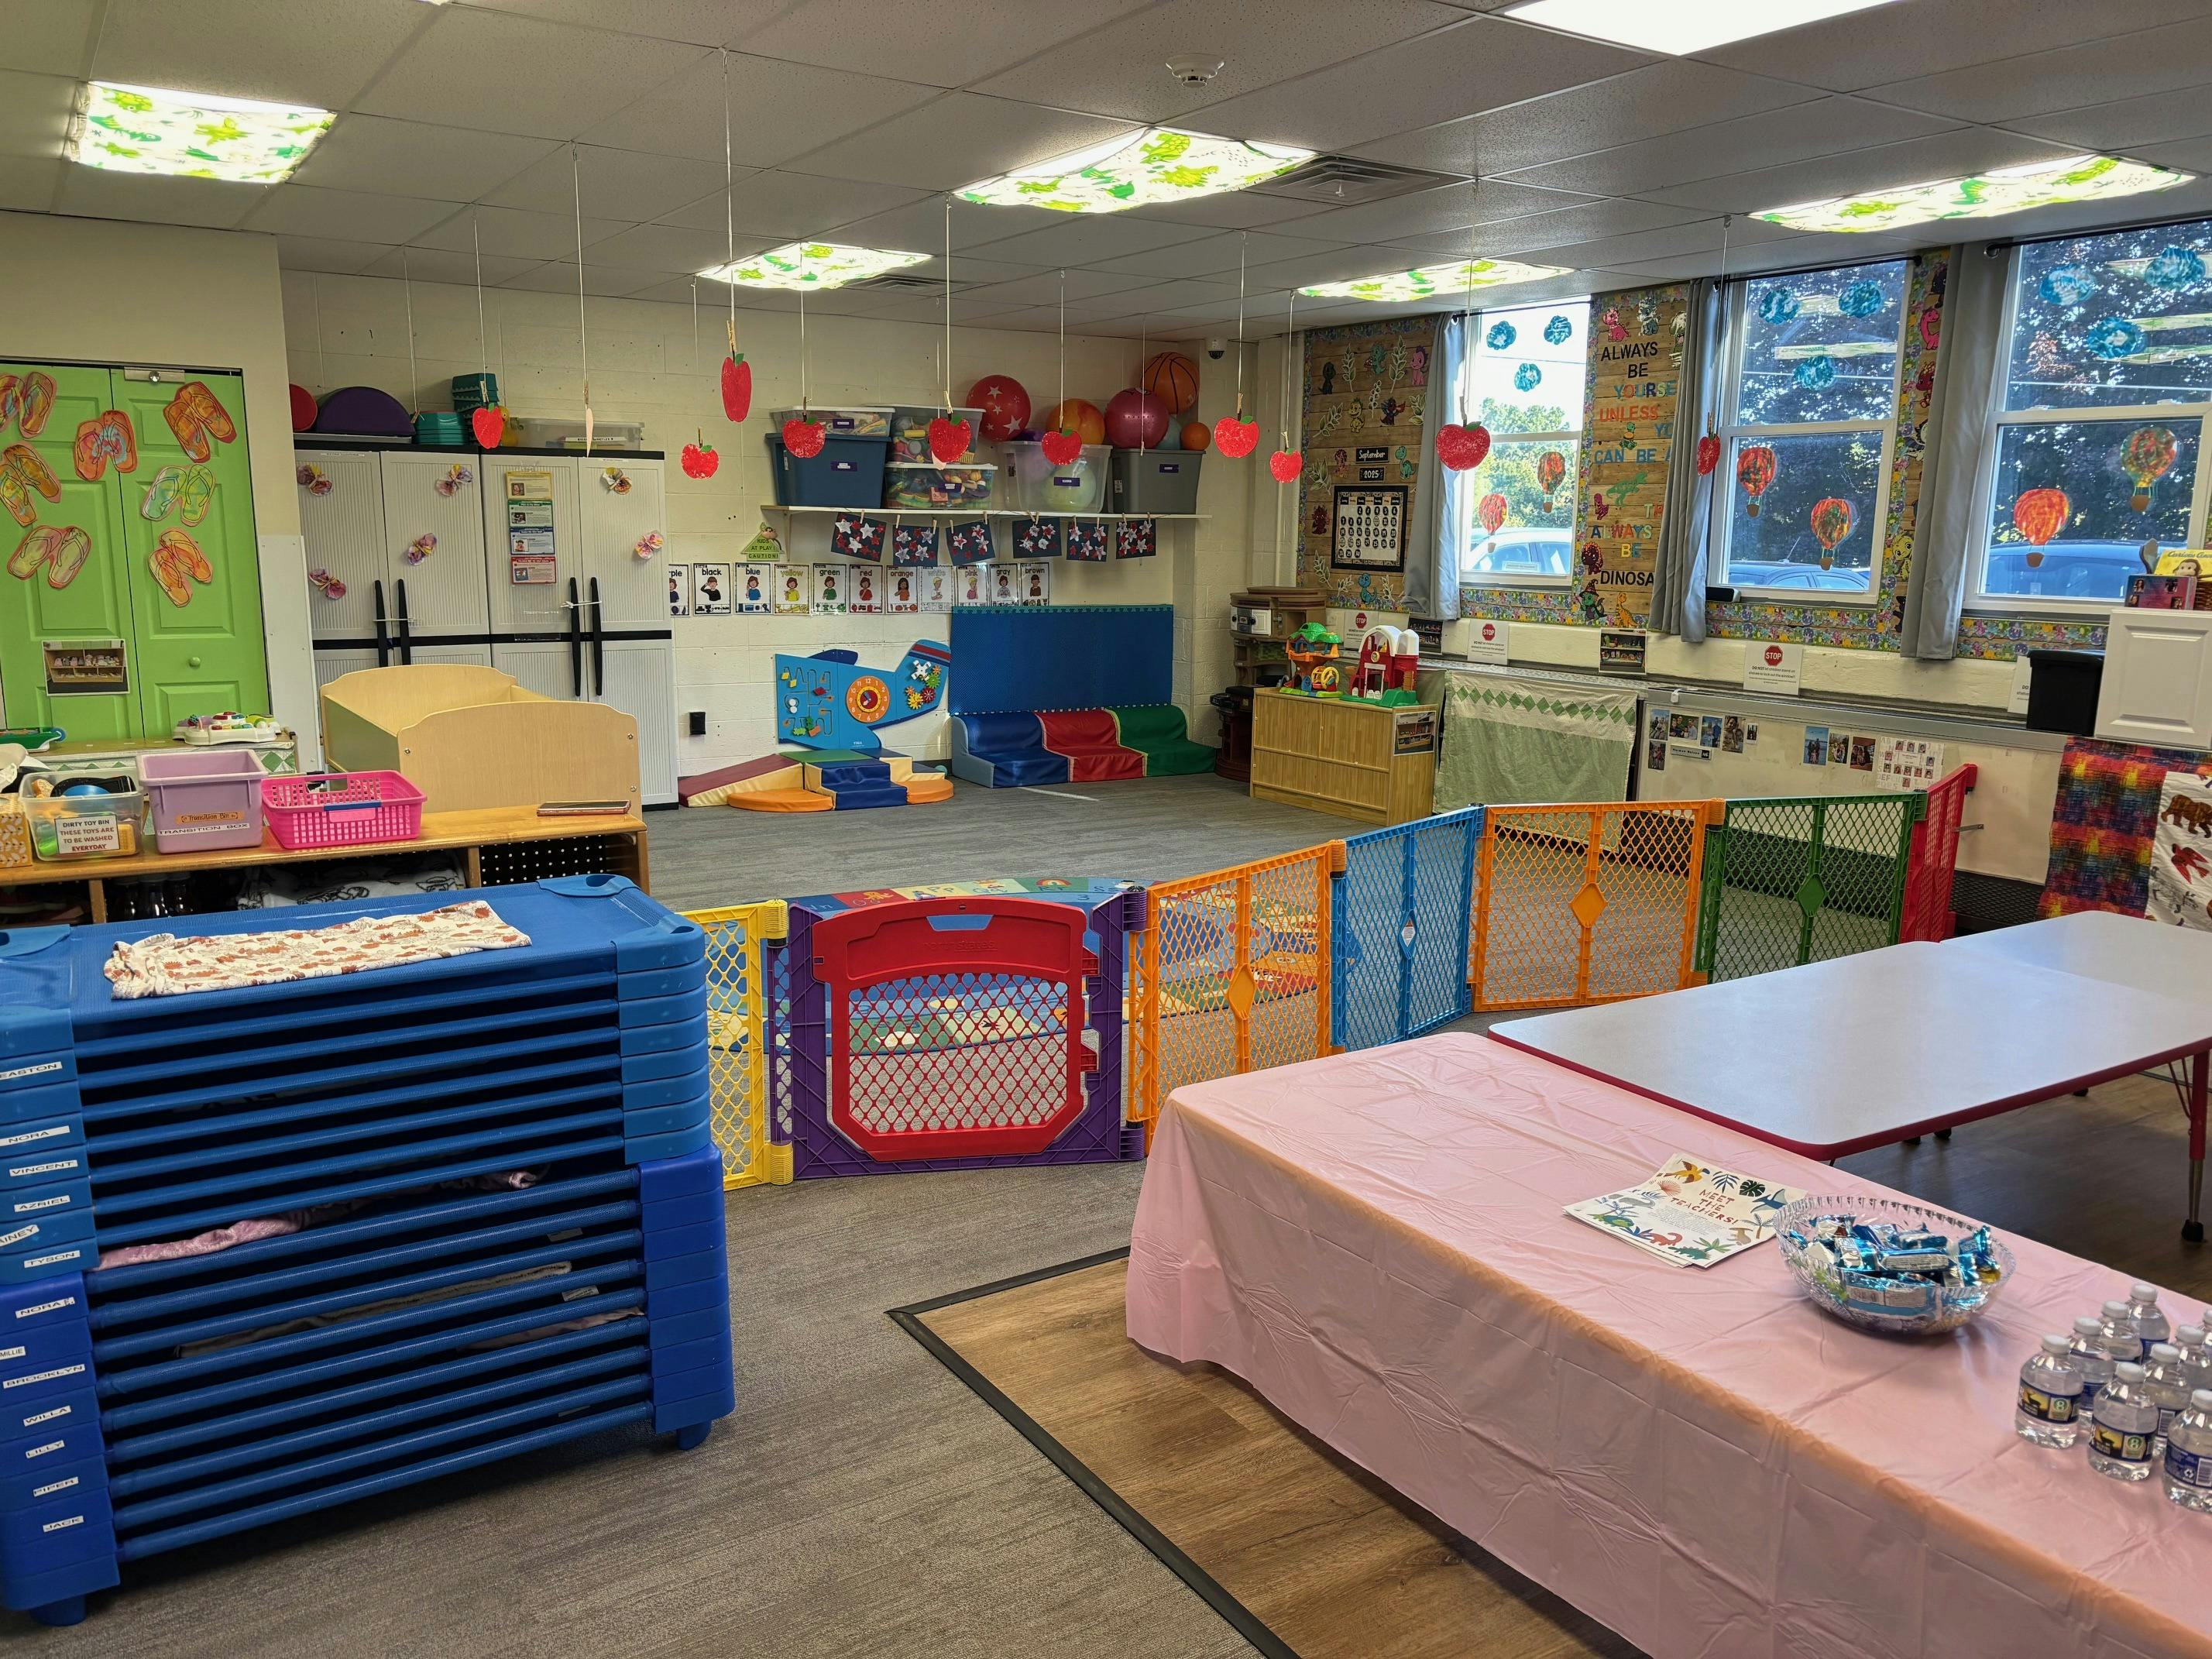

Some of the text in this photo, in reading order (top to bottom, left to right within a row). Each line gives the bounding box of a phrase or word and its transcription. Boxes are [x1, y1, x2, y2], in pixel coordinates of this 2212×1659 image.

[1601, 342, 1657, 361] ALWAYS
[1628, 362, 1648, 378] BE
[1614, 380, 1677, 400] YOURSE
[1599, 405, 1657, 421] UNLESS
[1358, 449, 1386, 461] September
[1595, 447, 1624, 464] CAN
[1637, 448, 1657, 463] BE
[1364, 470, 1379, 479] 2025
[1591, 524, 1652, 539] ALWAYS
[1621, 543, 1641, 558] BE
[0, 1064, 57, 1078] EASTON
[9, 1132, 49, 1142] NORA
[12, 1163, 74, 1174] VINCENT
[19, 1198, 67, 1210] AZRIEL
[1699, 1190, 1735, 1204] MEET
[1671, 1197, 1738, 1224] TEACHERS!
[1699, 1199, 1725, 1211] THE
[29, 1253, 74, 1266] TYSON
[20, 1302, 61, 1315] NORA
[7, 1366, 82, 1386] BROOKLYN
[26, 1408, 67, 1423] WILLA
[28, 1442, 62, 1457] LILLY
[34, 1479, 74, 1495] PIPER
[46, 1517, 81, 1530] JACK
